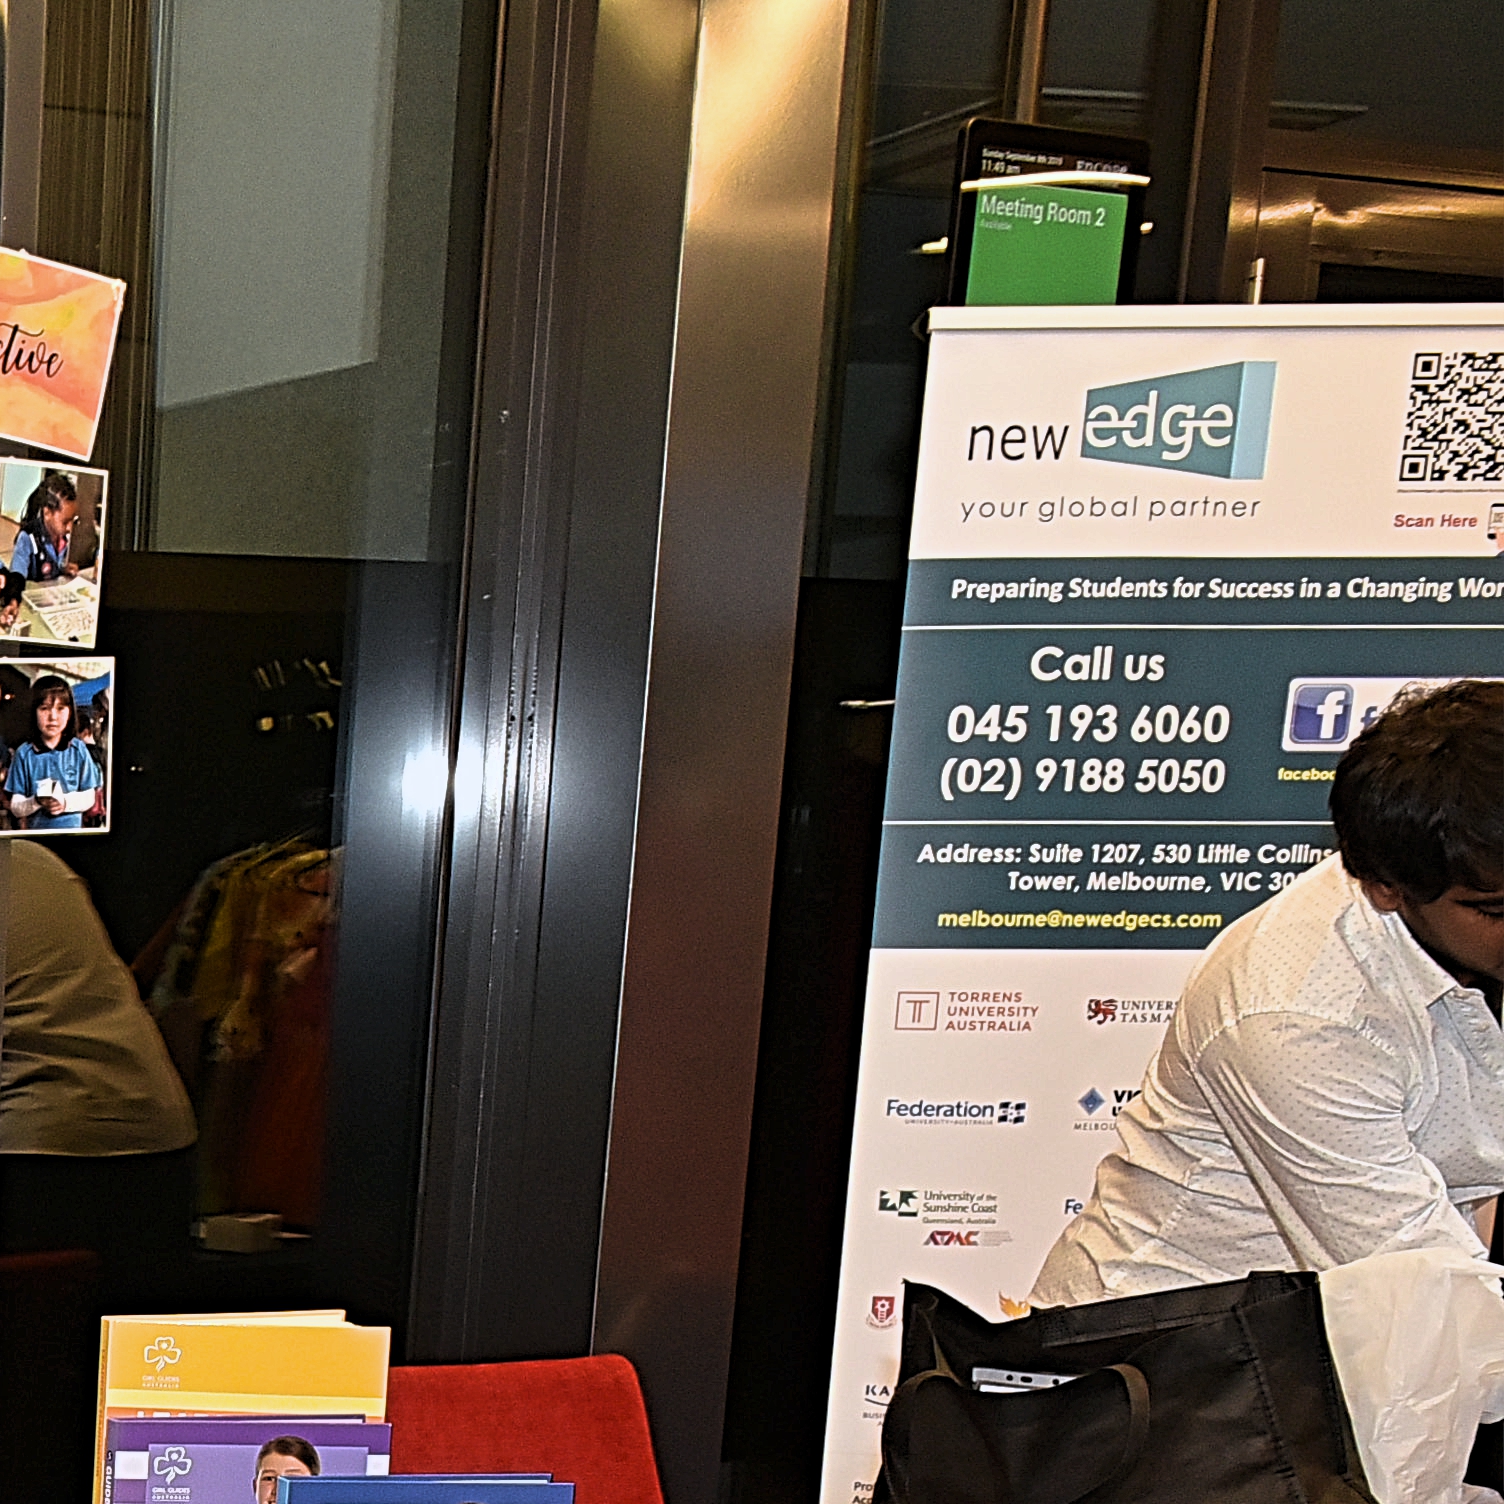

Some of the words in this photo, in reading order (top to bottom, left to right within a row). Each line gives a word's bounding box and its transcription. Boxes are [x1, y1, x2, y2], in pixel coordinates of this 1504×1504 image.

[982, 194, 1044, 224] Meeting
[1047, 202, 1091, 226] Room
[1095, 207, 1106, 228] 2
[966, 419, 1070, 462] new
[1084, 388, 1234, 462] edge
[960, 495, 1029, 523] your
[1037, 494, 1138, 523] global
[1148, 496, 1262, 523] partner
[1393, 513, 1435, 528] Scan
[1439, 513, 1478, 528] Here
[950, 577, 1064, 604] Preparing
[1068, 576, 1169, 600] Students
[1172, 576, 1203, 600] for
[1207, 576, 1294, 600] Success
[1300, 577, 1322, 600] in
[1326, 581, 1341, 600] a
[1346, 576, 1453, 604] Changing
[1458, 577, 1504, 599] Wor
[1029, 644, 1115, 682] Call
[1124, 652, 1165, 682] us
[947, 704, 1029, 743] 045
[1044, 704, 1119, 743] 193
[1130, 704, 1230, 743] 6060
[940, 757, 1022, 802] (02)
[1035, 757, 1125, 794] 9188
[1134, 757, 1227, 794] 5050
[916, 843, 1023, 865] Address:
[1027, 843, 1084, 865] Suite
[1090, 844, 1147, 868] 1207,
[1151, 843, 1191, 865] 530
[1196, 843, 1251, 865] Little
[1006, 871, 1081, 895] Tower,
[1085, 870, 1212, 894] Melbourne,
[1219, 871, 1262, 892] VIC
[937, 910, 1223, 932] melbourne@newedgecs.com
[947, 991, 1023, 1003] TORRENS
[1120, 999, 1178, 1012] UNIVER
[946, 1005, 1040, 1018] UNIVERSITY
[1119, 1012, 1172, 1024] TASMA
[944, 1020, 1033, 1032] AUSTRALIA
[885, 1098, 995, 1118] Federation
[1073, 1122, 1116, 1131] MELBOU
[923, 1189, 974, 1204] University
[922, 1201, 969, 1213] Sunshine
[970, 1202, 998, 1214] Coast
[853, 1481, 874, 1492] Pro
